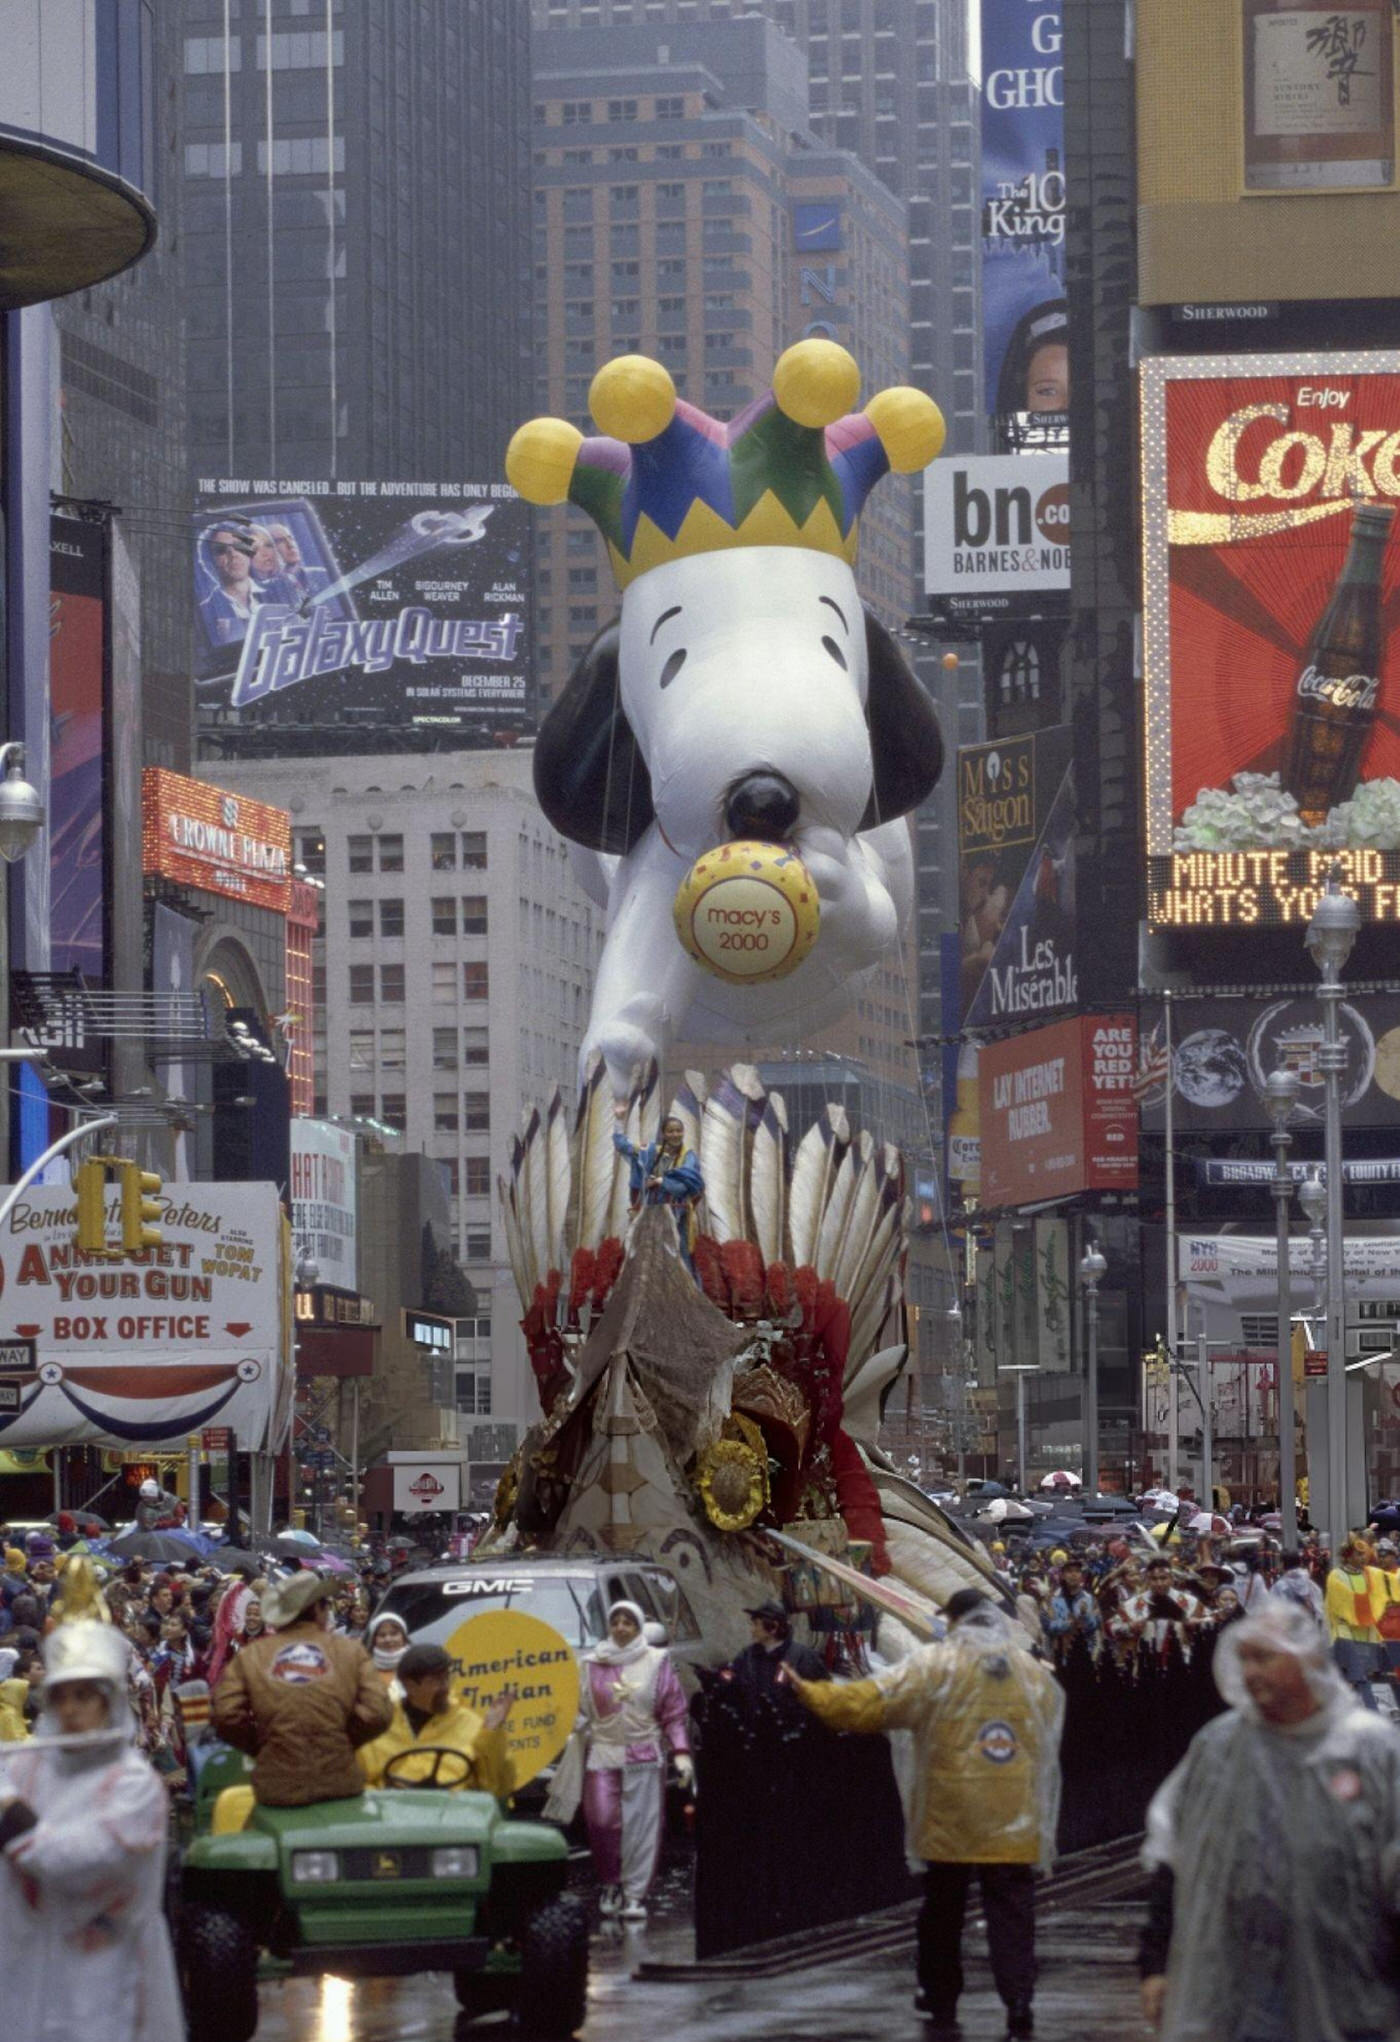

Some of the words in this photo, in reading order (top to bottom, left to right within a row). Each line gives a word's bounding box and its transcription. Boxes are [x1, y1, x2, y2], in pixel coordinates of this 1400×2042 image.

[1297, 387, 1350, 408] Enjoy
[198, 479, 216, 493] THE
[219, 479, 250, 494] SHOW
[253, 480, 277, 494] WAS
[360, 482, 377, 495] THE
[380, 483, 437, 497] ADVENTURE
[440, 484, 461, 497] HAS
[463, 484, 488, 498] ONLY
[376, 580, 392, 590] TIM
[415, 581, 469, 591] SIGOURNEY
[492, 583, 516, 592] ALAN
[370, 591, 399, 600] ALLEN
[424, 592, 460, 601] WEAVER
[484, 593, 525, 602] RICKMAN
[462, 675, 510, 688] DECEMBER
[513, 676, 526, 688] 25
[417, 687, 440, 697] SOLAR
[442, 688, 476, 698] SYSTEMS
[479, 688, 525, 698] EVERYWHERE
[708, 908, 780, 928] macy's
[720, 932, 768, 950] 2000
[1021, 925, 1054, 973] Les
[1094, 1028, 1132, 1042] ARE
[1092, 1044, 1132, 1058] YOU
[1094, 1059, 1132, 1073] RED
[1014, 1058, 1065, 1100] INTERNET
[1091, 1074, 1134, 1089] YET?
[214, 1244, 255, 1265] TOM
[201, 1259, 263, 1283] WOPAT
[56, 1271, 141, 1301] YOUR
[145, 1270, 212, 1301] GUN
[53, 1317, 108, 1339] BOX
[117, 1316, 211, 1339] OFFICE
[442, 1579, 535, 1595] GMC
[450, 1650, 569, 1677] American
